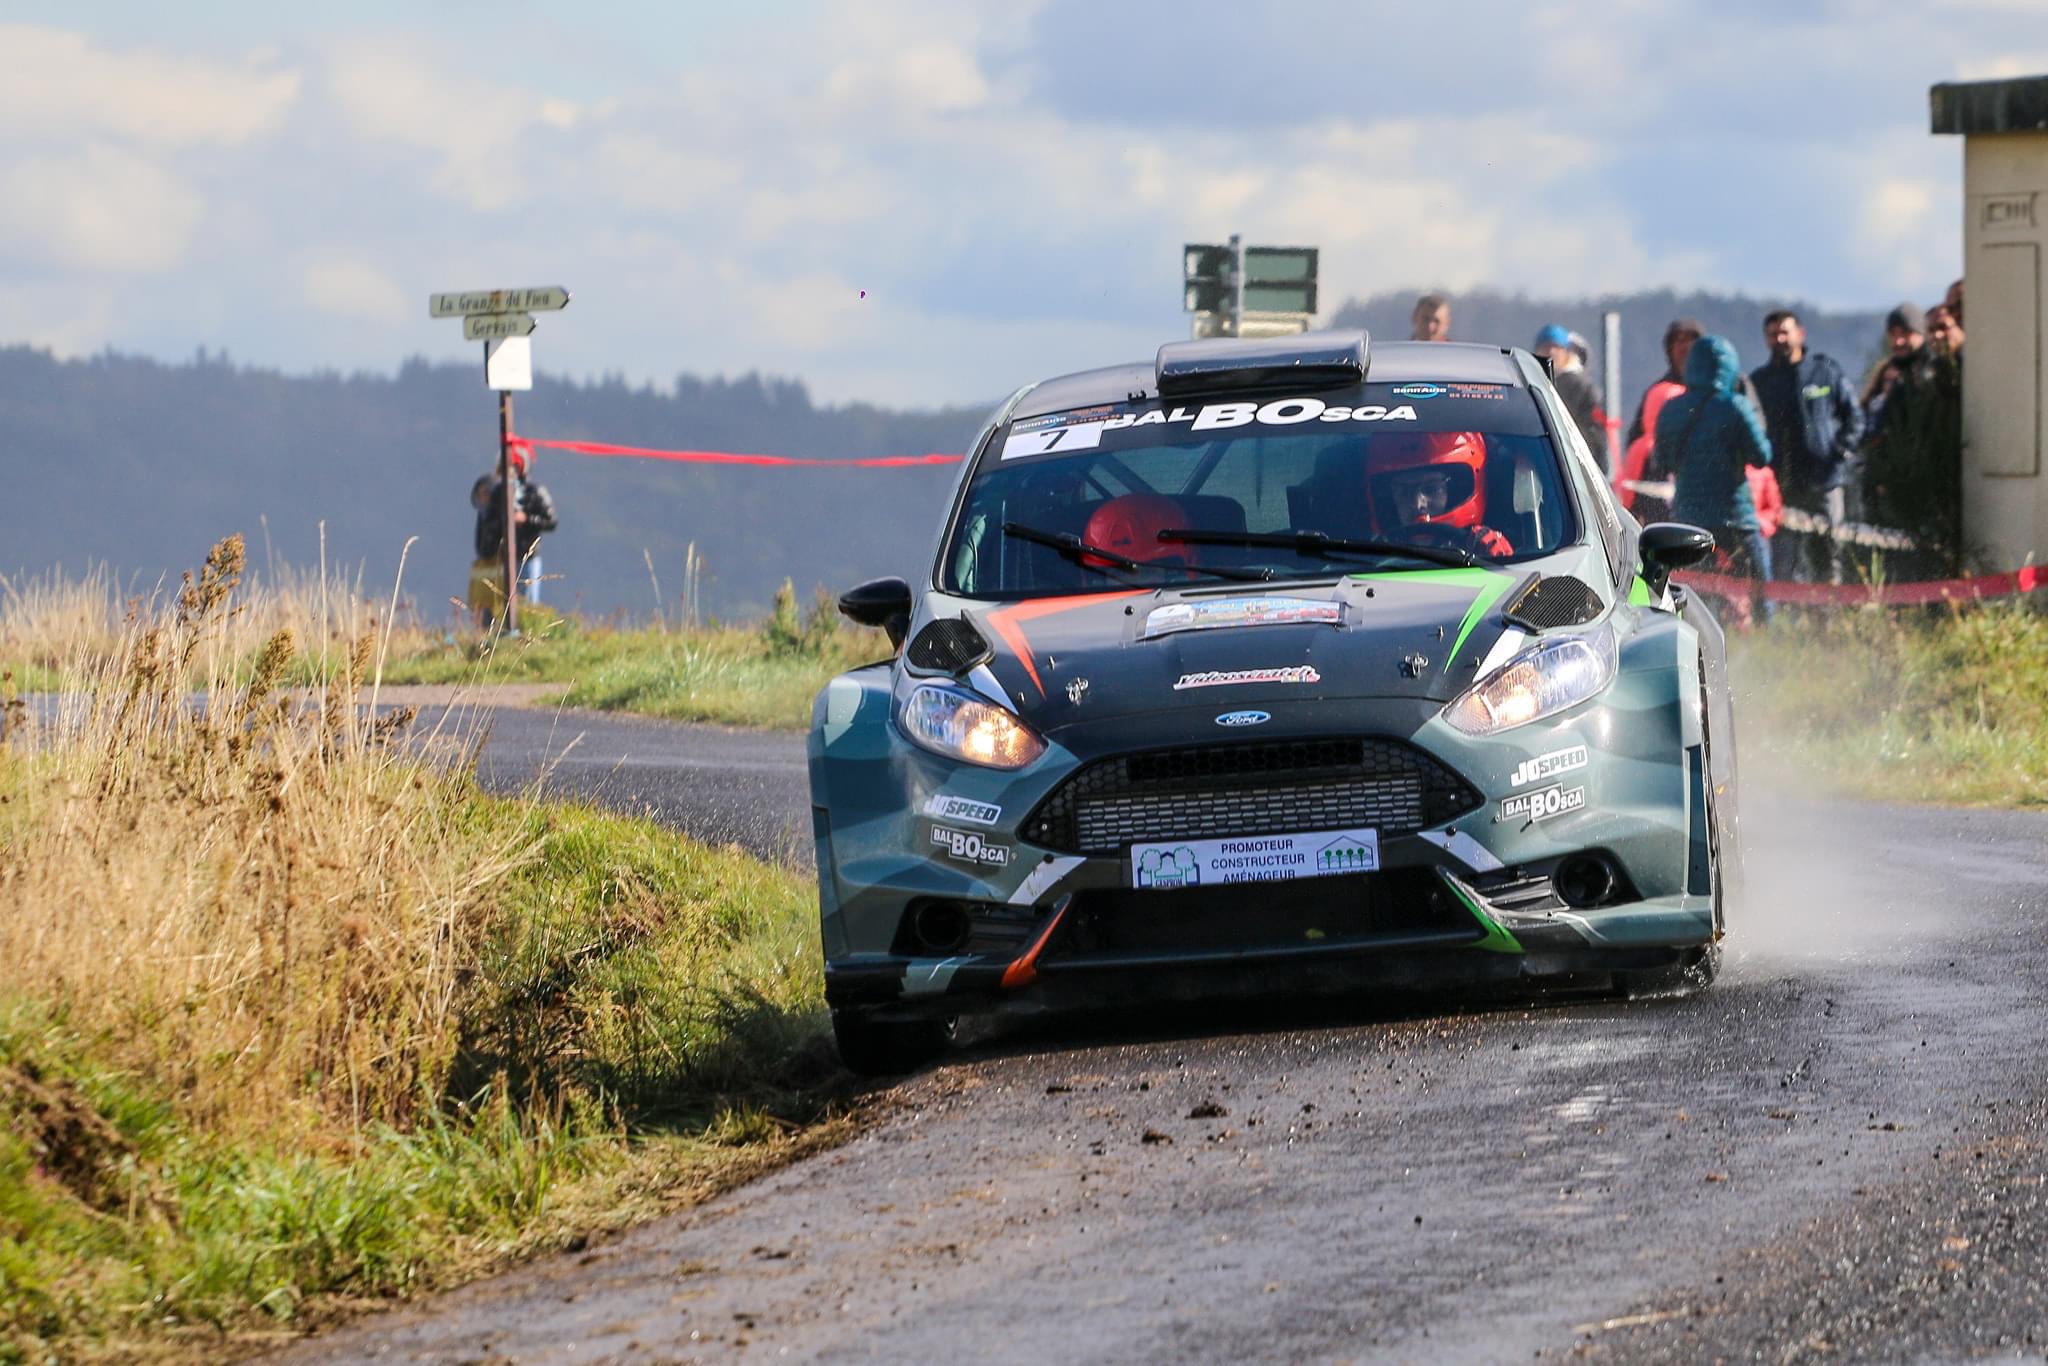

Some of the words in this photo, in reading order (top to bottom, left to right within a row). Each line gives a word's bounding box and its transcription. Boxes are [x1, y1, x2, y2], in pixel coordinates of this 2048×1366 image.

[440, 295, 453, 312] La
[505, 289, 521, 309] du
[1101, 398, 1417, 432] BALBOSCA
[1039, 428, 1069, 451] 7
[1221, 839, 1294, 854] PROMOTEUR
[1211, 853, 1306, 870] CONSTRUCTEUR
[1223, 868, 1297, 885] AMÉNAGEUR
